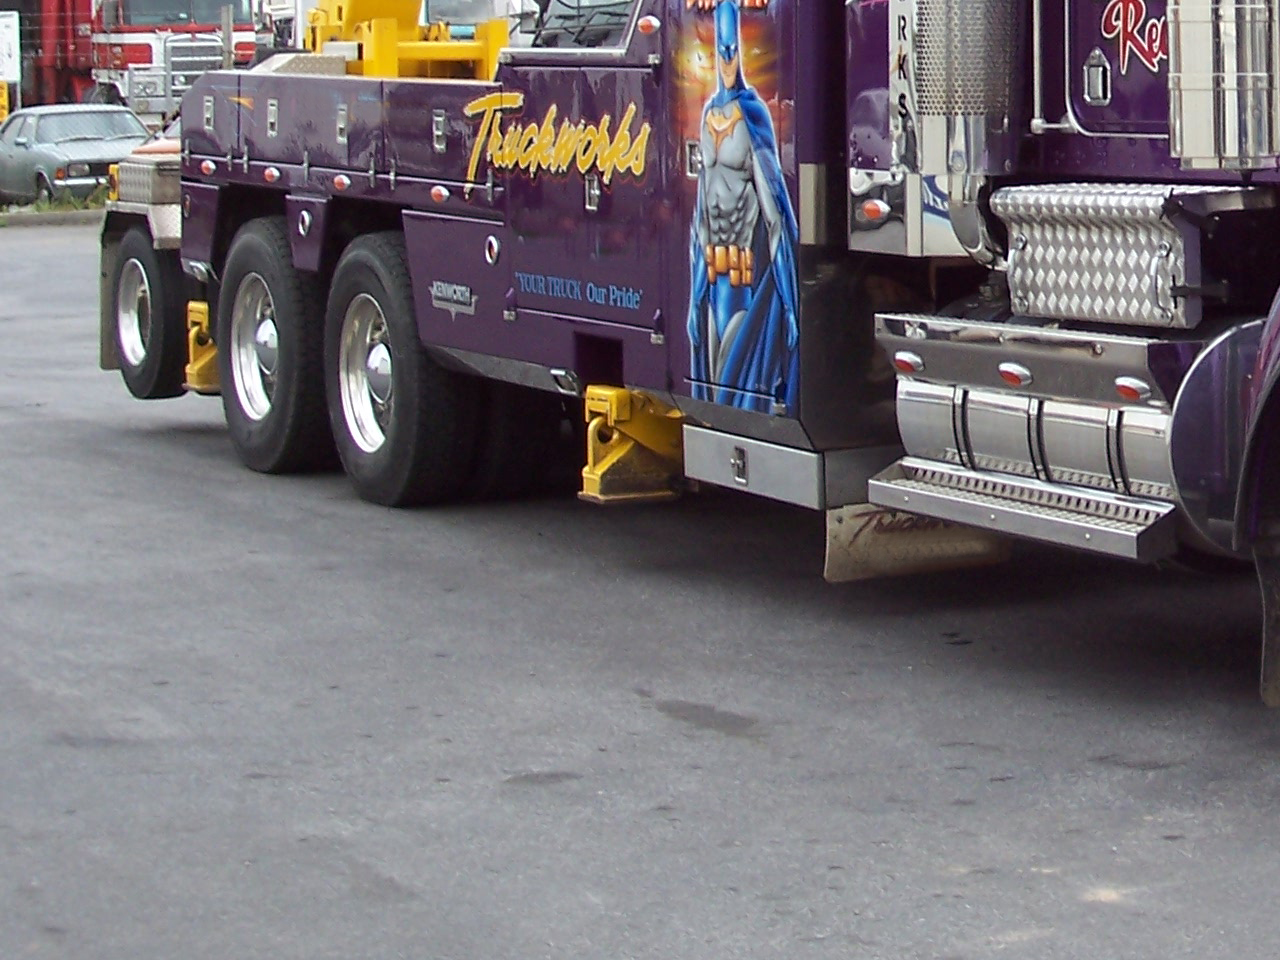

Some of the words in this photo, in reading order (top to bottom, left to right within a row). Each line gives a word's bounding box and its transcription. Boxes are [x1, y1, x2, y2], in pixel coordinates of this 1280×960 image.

[463, 91, 651, 200] Truckworks
[547, 275, 582, 300] TRUCK
[586, 281, 607, 304] Our
